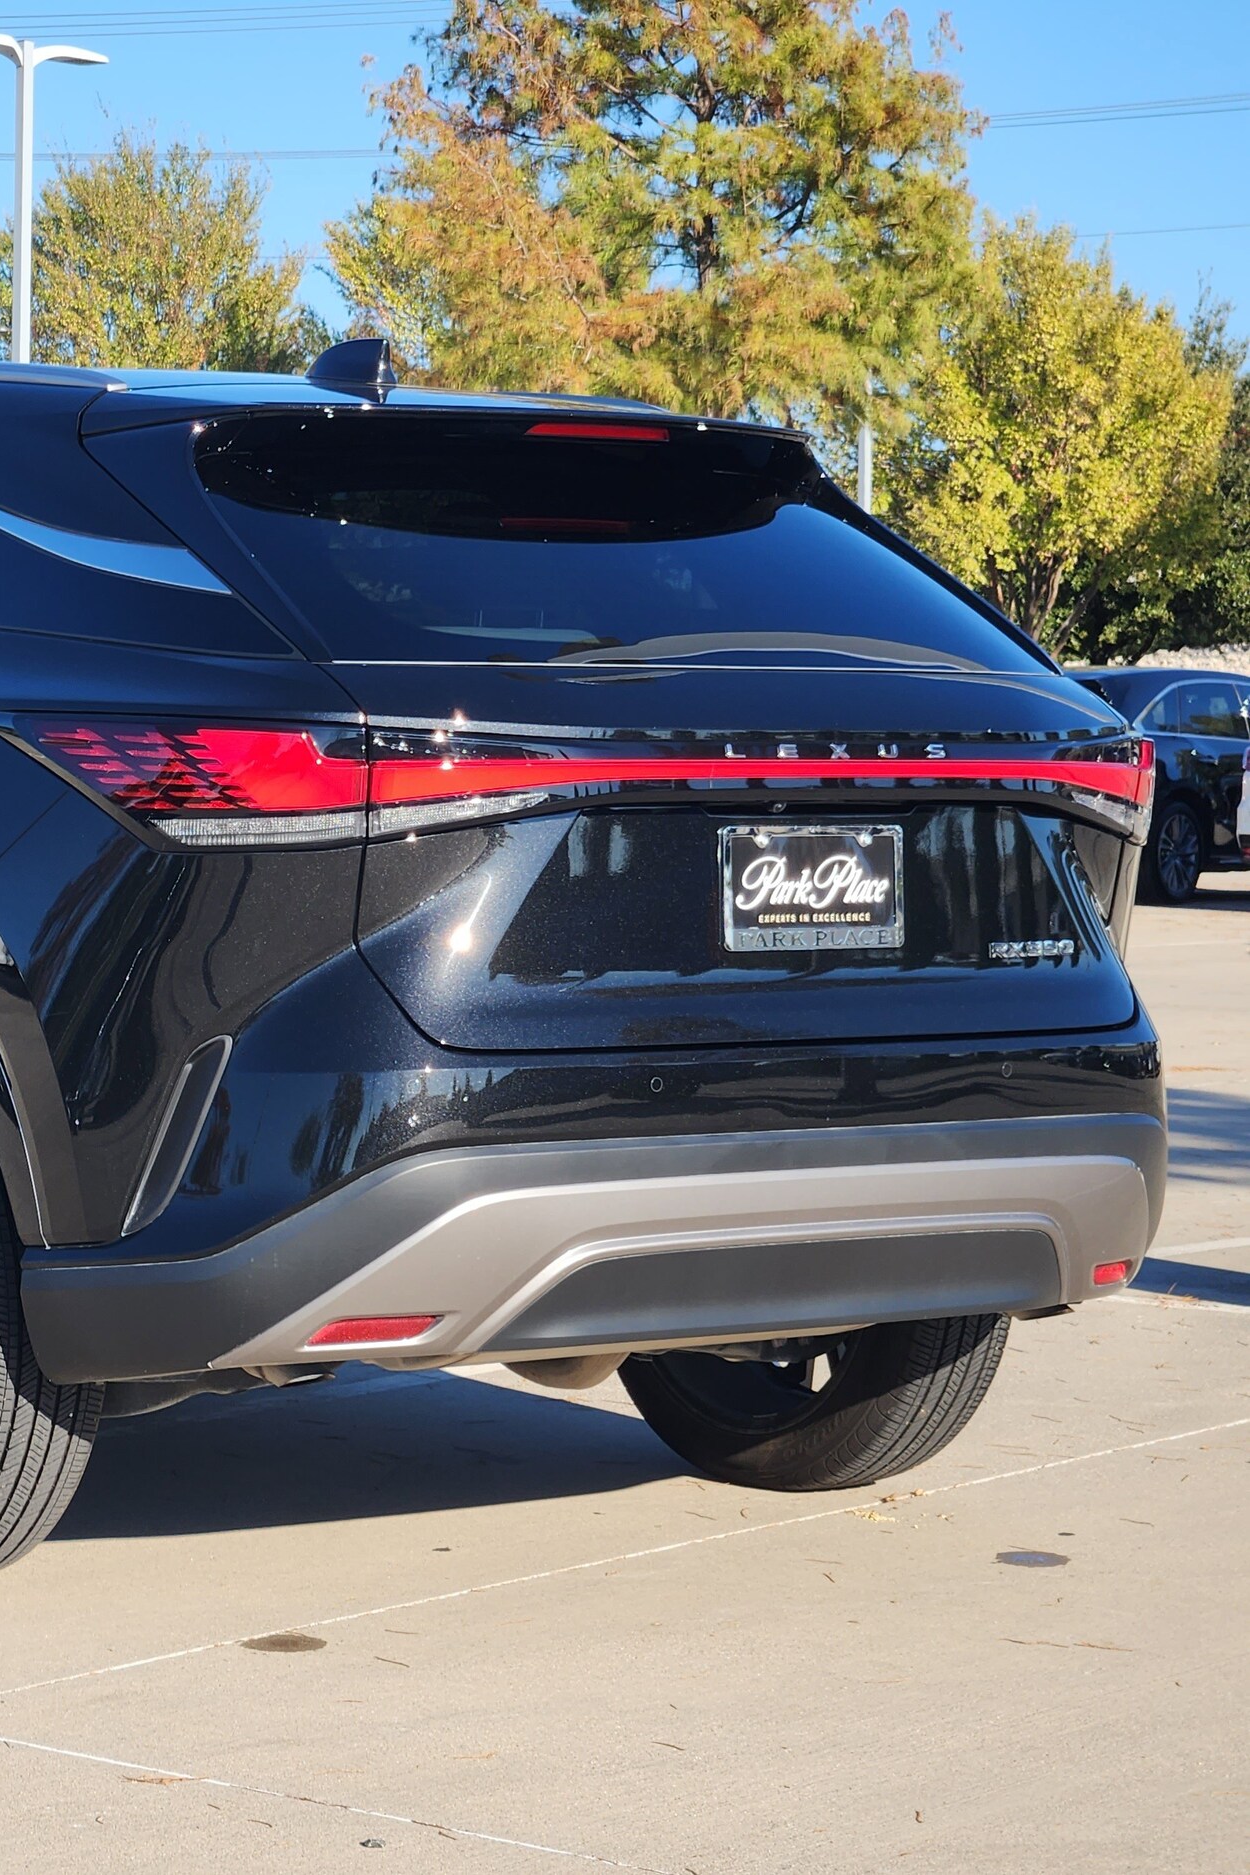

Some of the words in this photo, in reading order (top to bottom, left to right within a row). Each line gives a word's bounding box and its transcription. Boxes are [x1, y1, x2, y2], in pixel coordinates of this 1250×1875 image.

[724, 743, 946, 759] LEXUS
[735, 855, 812, 910] Park
[808, 855, 890, 909] Place
[758, 913, 797, 923] EXPERTS
[799, 913, 810, 922] IN
[812, 912, 871, 922] EXCELLENCE
[738, 931, 805, 948] PARK
[815, 929, 890, 946] PLACE
